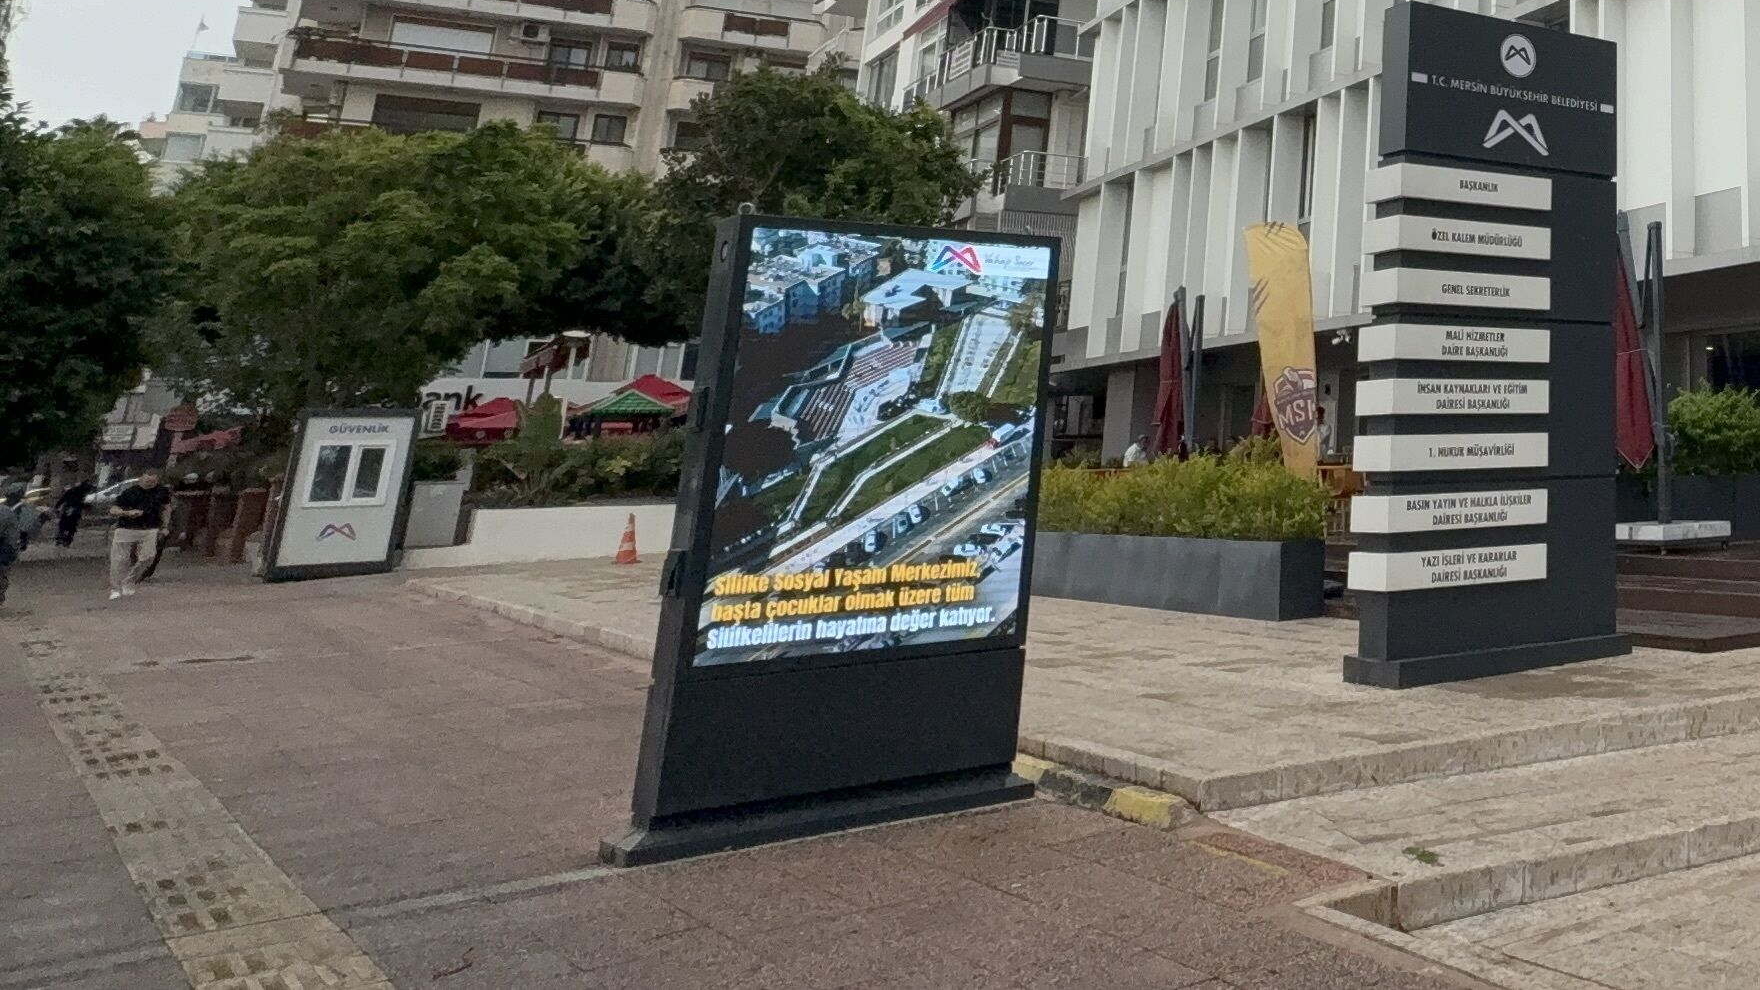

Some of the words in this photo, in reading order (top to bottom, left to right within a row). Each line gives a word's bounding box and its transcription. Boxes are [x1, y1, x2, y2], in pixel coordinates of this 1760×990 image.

[1432, 74, 1448, 87] T.C.
[1450, 78, 1487, 93] MERSİN
[1551, 94, 1598, 112] BELEDİYESİ
[1459, 179, 1498, 193] BAŞKANLIK
[1431, 228, 1449, 242] ÖZEL
[1451, 232, 1475, 243] KALEM
[1441, 283, 1464, 295] GENEL
[1466, 284, 1510, 298] SEKRETERLİK
[1445, 329, 1464, 341] MALİ
[1466, 330, 1505, 343] HİZMETLER
[1441, 344, 1464, 356] DAİRE
[1466, 344, 1508, 358] BAŞKANLIĞI
[1417, 380, 1441, 395] İNSAN
[1443, 383, 1491, 395] KAYNAKLARI
[1492, 384, 1502, 395] VE
[1503, 382, 1528, 395] EĞİTİM
[1436, 397, 1466, 410] DAİRESİ
[1467, 397, 1511, 412] BAŞKANLIĞI
[329, 422, 390, 434] GÜVENLİK
[1429, 447, 1436, 458] 1.
[1438, 446, 1464, 458] HUKUK
[1466, 443, 1515, 458] MÜŞAVİRLİĞİ
[1406, 500, 1430, 511] BASIN
[1432, 498, 1456, 510] YAYIN
[1459, 497, 1469, 508] VE
[1470, 496, 1498, 507] HALKLA
[1500, 493, 1532, 508] İLİŞKİLER
[1432, 511, 1461, 525] DAİRESİ
[1464, 509, 1508, 525] BAŞKANLIĞI
[1420, 556, 1439, 567] YAZI
[1441, 552, 1464, 567] İŞLERİ
[1466, 553, 1476, 564] VE
[1478, 551, 1517, 563] KARARLAR
[714, 573, 769, 596] Silifke
[774, 569, 830, 592] Sosyal
[834, 566, 887, 590] Yaşam
[1431, 567, 1461, 583] DAİRESİ
[1463, 565, 1507, 581] BAŞKANLIĞI
[710, 600, 761, 626] başta
[766, 594, 842, 624] çocuklar
[845, 589, 895, 612] olmak
[899, 586, 941, 606] üzere
[945, 584, 975, 602] tüm
[707, 622, 812, 650] Silifkelilerin
[815, 615, 887, 640] hayatına
[890, 610, 935, 632] değer
[939, 605, 997, 627] katıyor.
